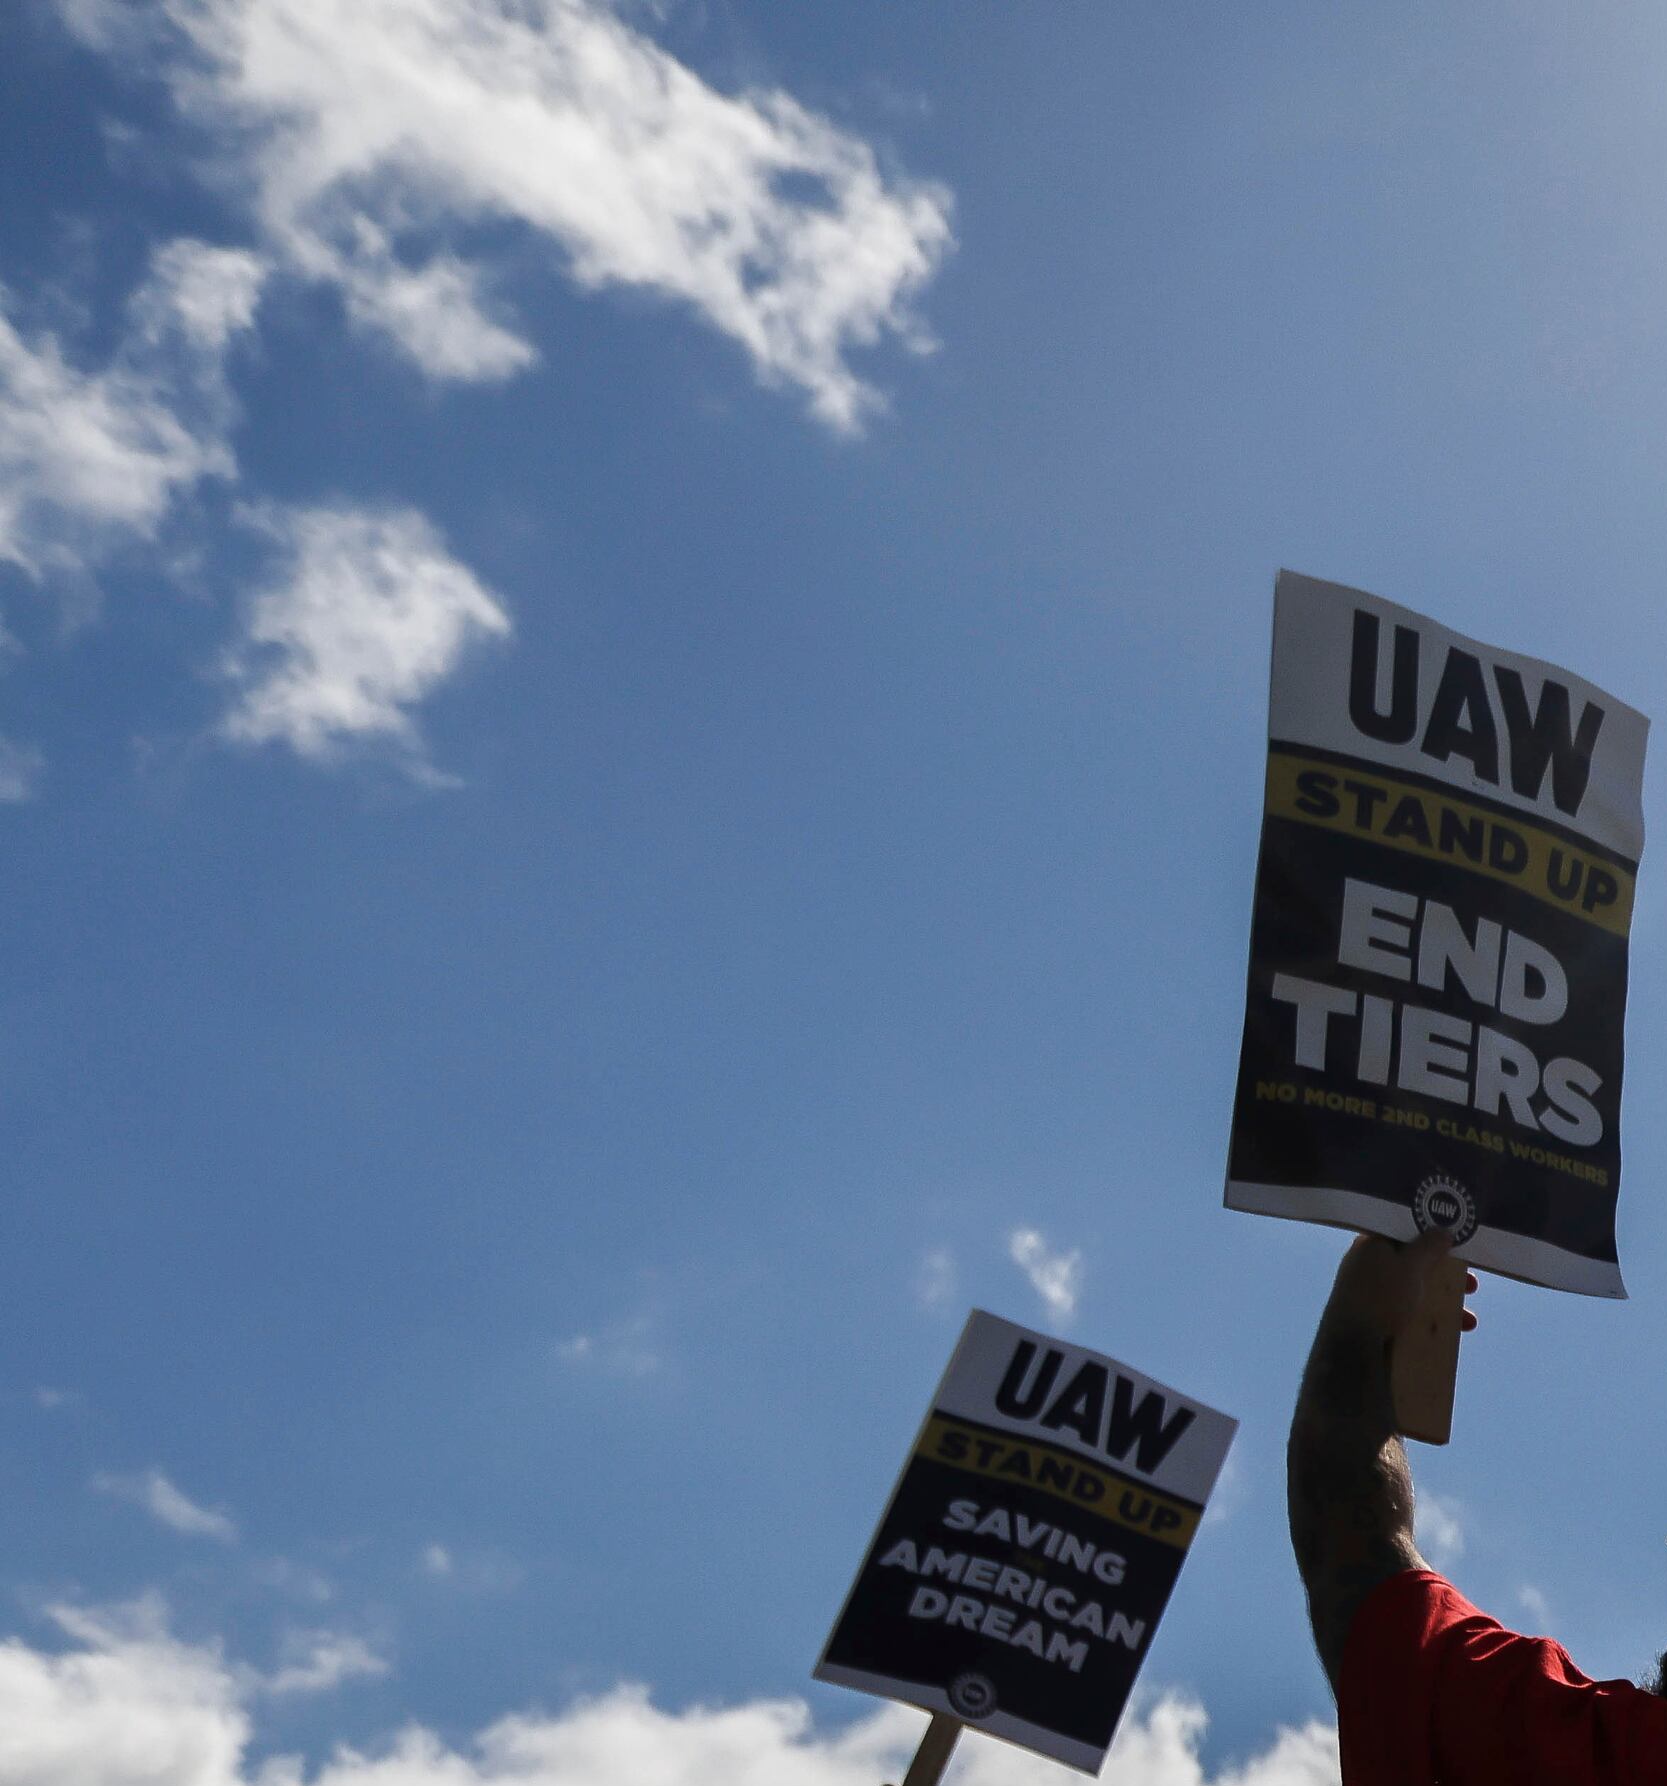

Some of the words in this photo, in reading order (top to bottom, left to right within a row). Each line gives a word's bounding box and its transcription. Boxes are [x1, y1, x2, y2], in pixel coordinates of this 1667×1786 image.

[1349, 608, 1605, 818] UAW
[1296, 770, 1530, 876] STAND
[1545, 844, 1620, 914] UP
[1338, 877, 1569, 1026] END
[1271, 972, 1604, 1148] TIERS
[1256, 1081, 1297, 1103] NO
[1304, 1087, 1377, 1118] MORE
[1382, 1106, 1431, 1130] 2ND
[1436, 1119, 1504, 1154] CLASS
[1509, 1141, 1609, 1187] WORKERS
[1431, 1199, 1458, 1219] UAW
[994, 1340, 1197, 1476] UAW
[936, 1430, 1106, 1504] STAND
[1118, 1490, 1183, 1534] UP
[879, 1540, 1146, 1650] AMERICAN
[943, 1499, 1127, 1586] SAVING
[908, 1587, 1090, 1673] DREAM
